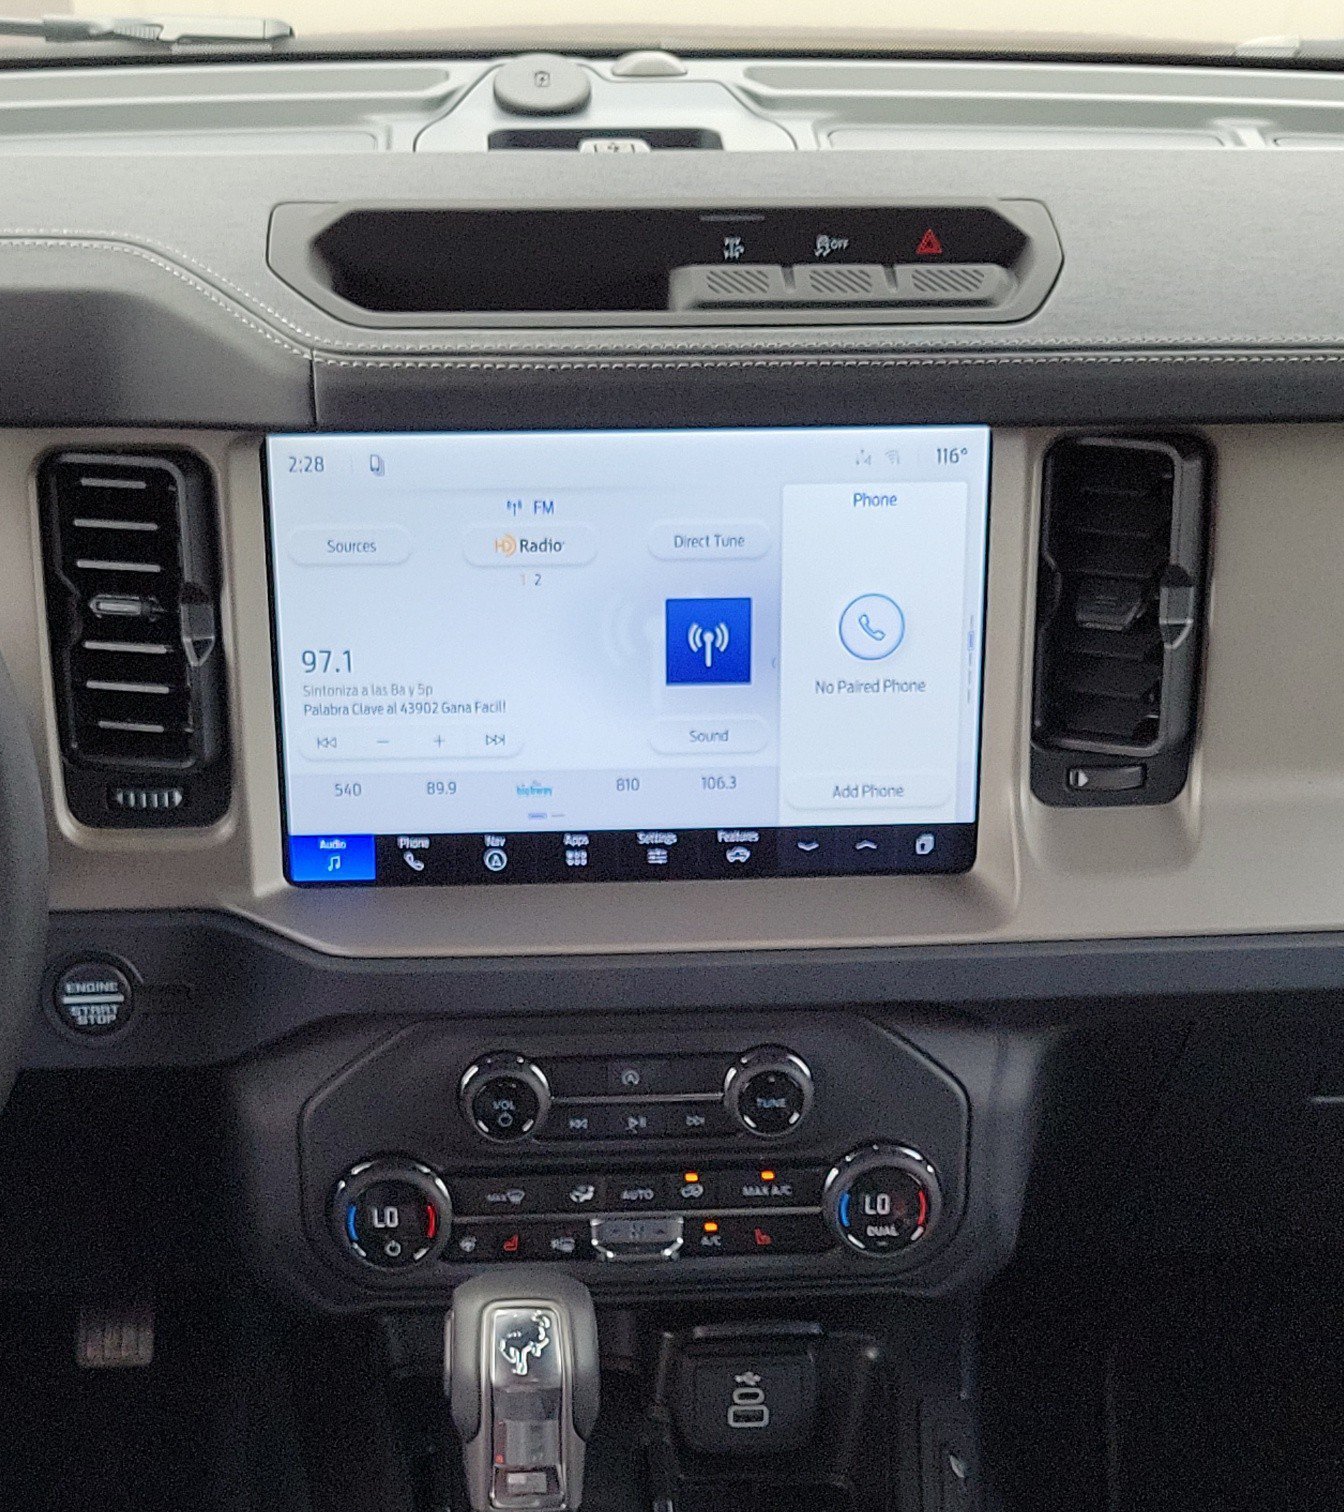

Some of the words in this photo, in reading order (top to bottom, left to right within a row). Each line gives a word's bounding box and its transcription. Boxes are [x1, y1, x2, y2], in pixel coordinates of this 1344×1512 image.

[936, 447, 968, 464] 116°
[288, 456, 325, 473] 2:28
[853, 492, 898, 508] Phone
[533, 501, 555, 515] FM
[326, 539, 377, 553] Sources
[519, 538, 563, 553] Radio
[674, 534, 709, 549] Direct
[713, 534, 745, 548] Tune
[534, 574, 542, 587] 2
[301, 650, 353, 674] 97.1
[303, 684, 358, 698] Sintoniza
[361, 687, 369, 697] a
[372, 684, 387, 697] las
[418, 683, 433, 698] 5p
[815, 680, 834, 694] No
[838, 679, 880, 694] Paired
[883, 678, 926, 694] Phone
[304, 703, 349, 717] Palabra
[352, 702, 384, 716] Clave
[386, 702, 397, 715] al
[400, 702, 439, 715] 43902
[442, 702, 472, 714] Gana
[689, 728, 729, 743] Sound
[334, 783, 362, 798] 540
[426, 781, 457, 796] 89.9
[616, 778, 640, 792] 810
[701, 776, 737, 790] 106.3
[832, 784, 859, 799] Add
[861, 783, 905, 799] Phone
[319, 838, 347, 850] Audio
[397, 835, 431, 850] Phone
[563, 833, 590, 848] Apps
[636, 831, 678, 846] Settings
[717, 830, 760, 844] Features
[65, 981, 119, 994] ENGINE
[70, 1004, 119, 1016] START
[76, 1014, 117, 1026] STOP
[622, 1188, 654, 1201] AUTO
[864, 1193, 891, 1216] LO
[373, 1207, 399, 1228] LO
[866, 1223, 899, 1237] DUAL
